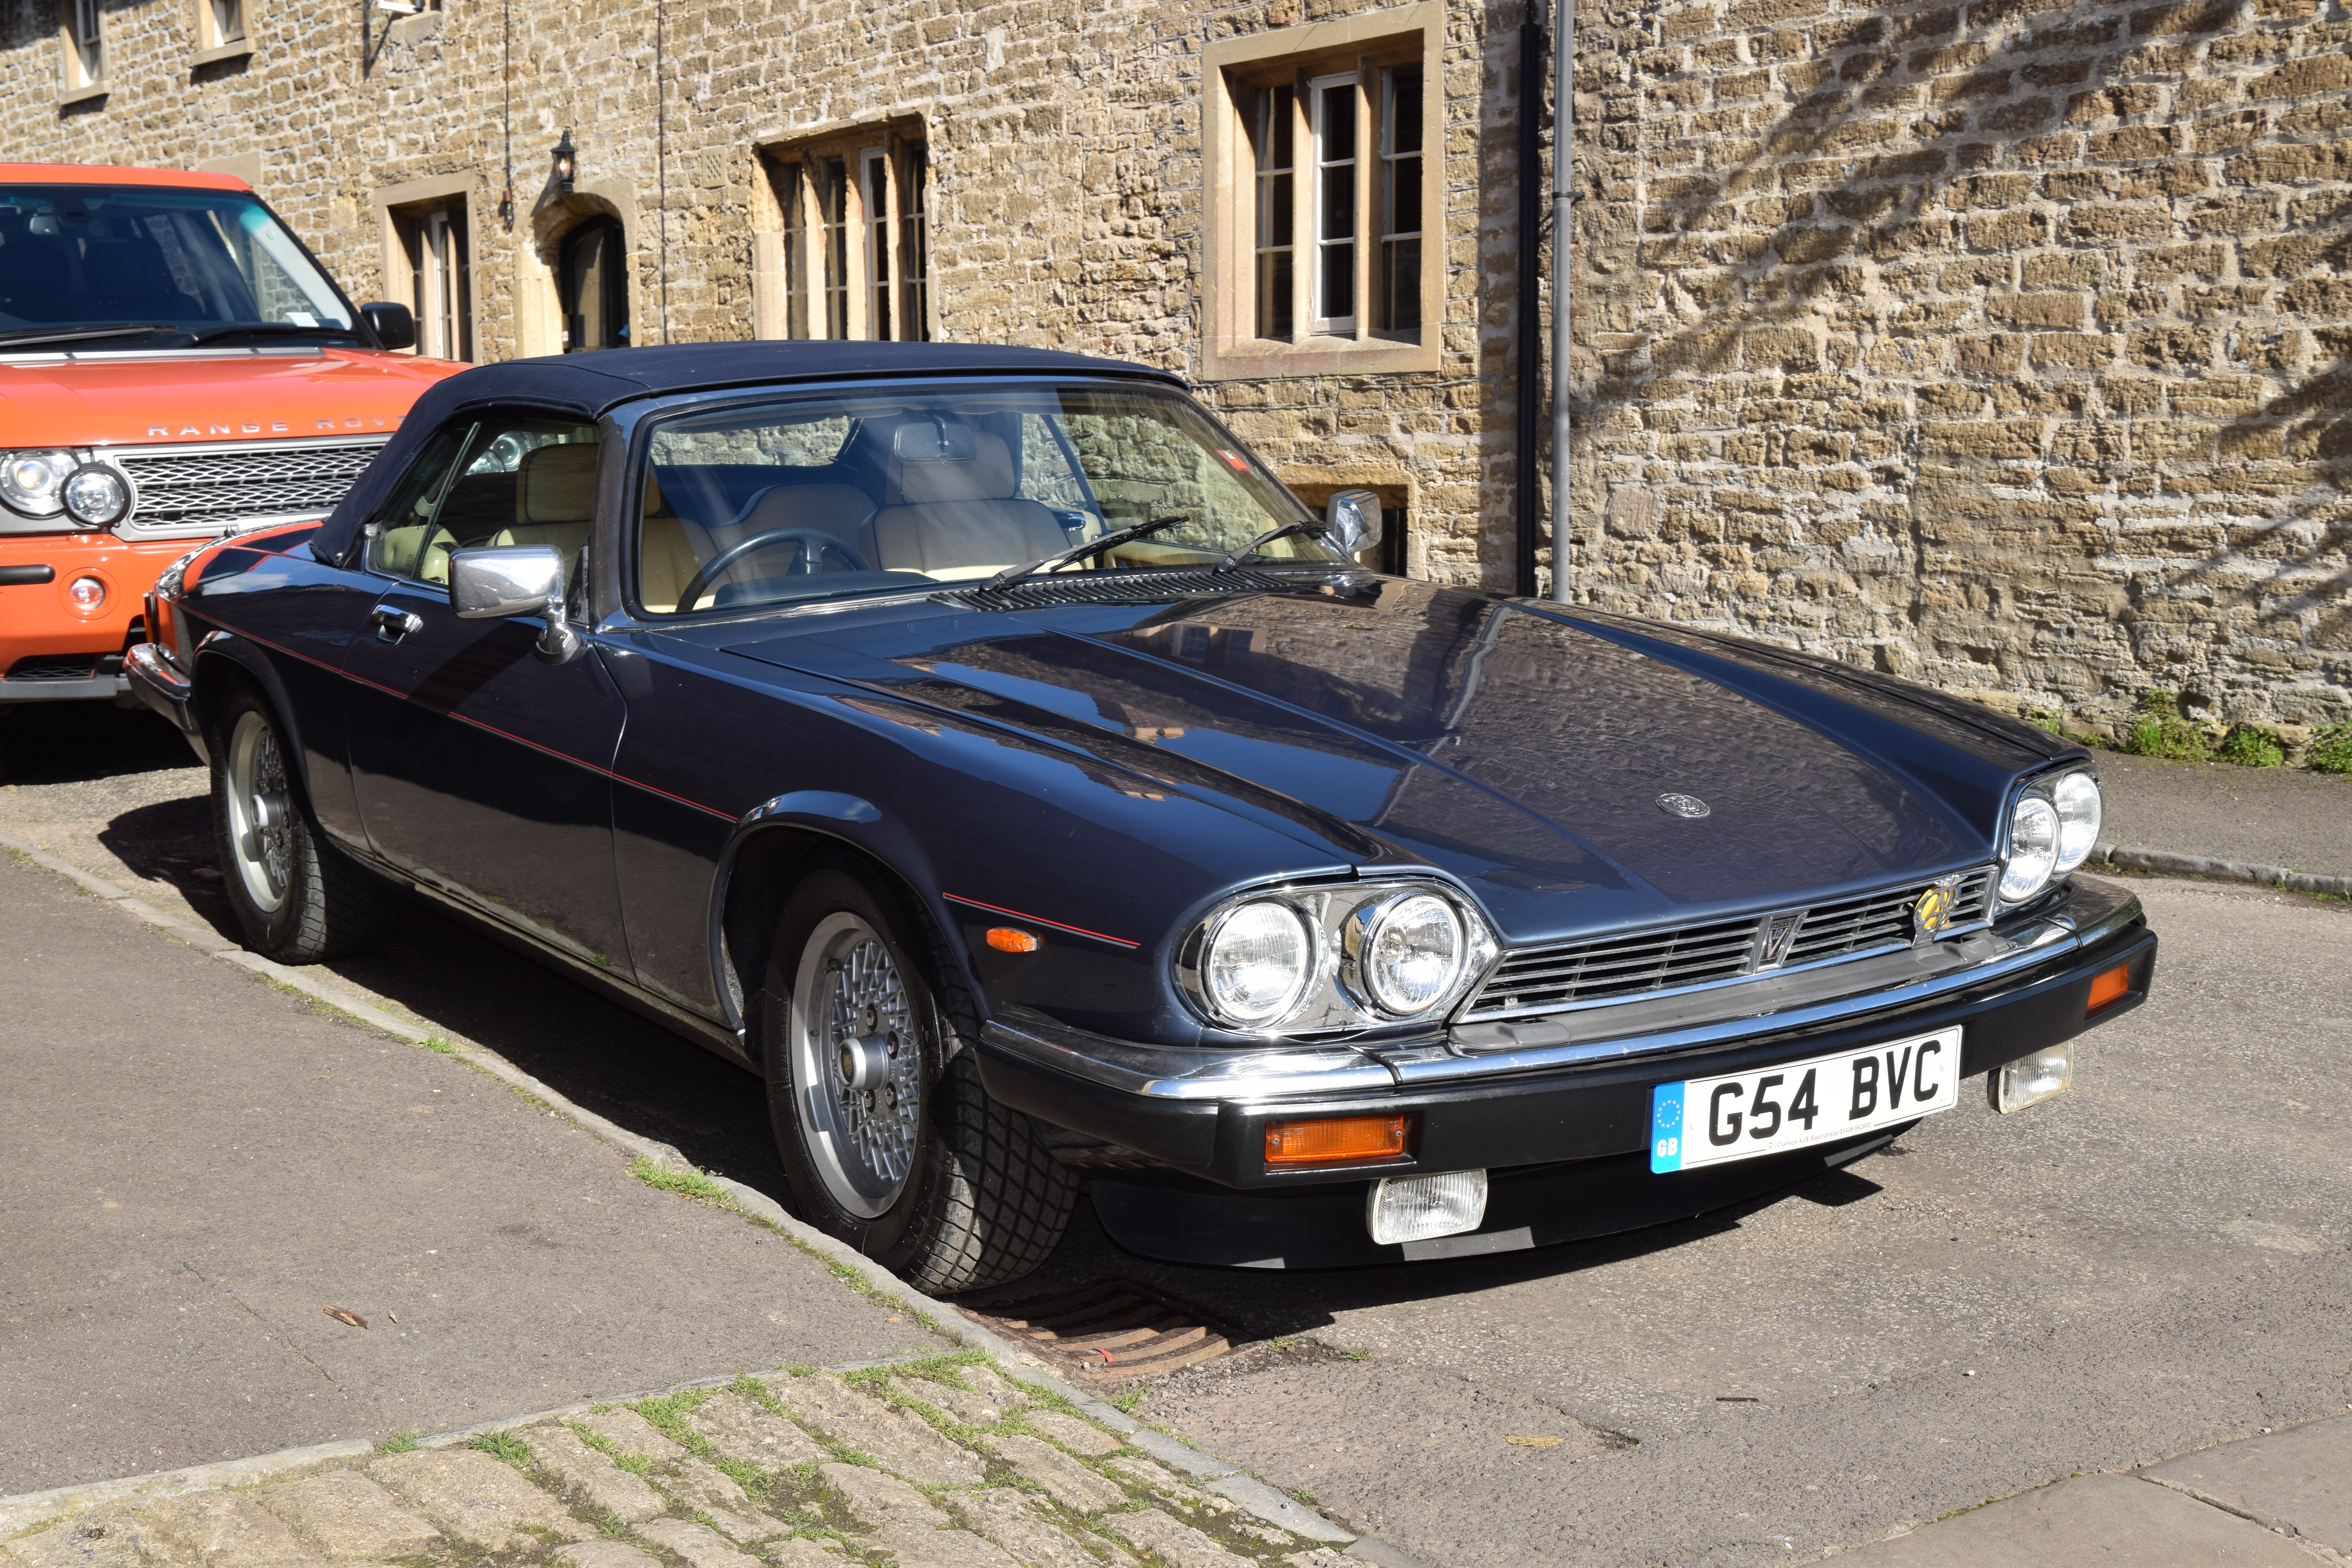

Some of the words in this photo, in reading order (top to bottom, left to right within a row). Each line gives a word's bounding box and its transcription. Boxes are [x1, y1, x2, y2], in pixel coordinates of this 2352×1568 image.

[148, 422, 289, 436] RANGE
[1709, 1068, 1818, 1146] G54
[1849, 1040, 1941, 1120] BVC
[1811, 1130, 1838, 1141] Specialists
[1855, 1122, 1871, 1131] 863800
[1657, 1138, 1678, 1157] GB
